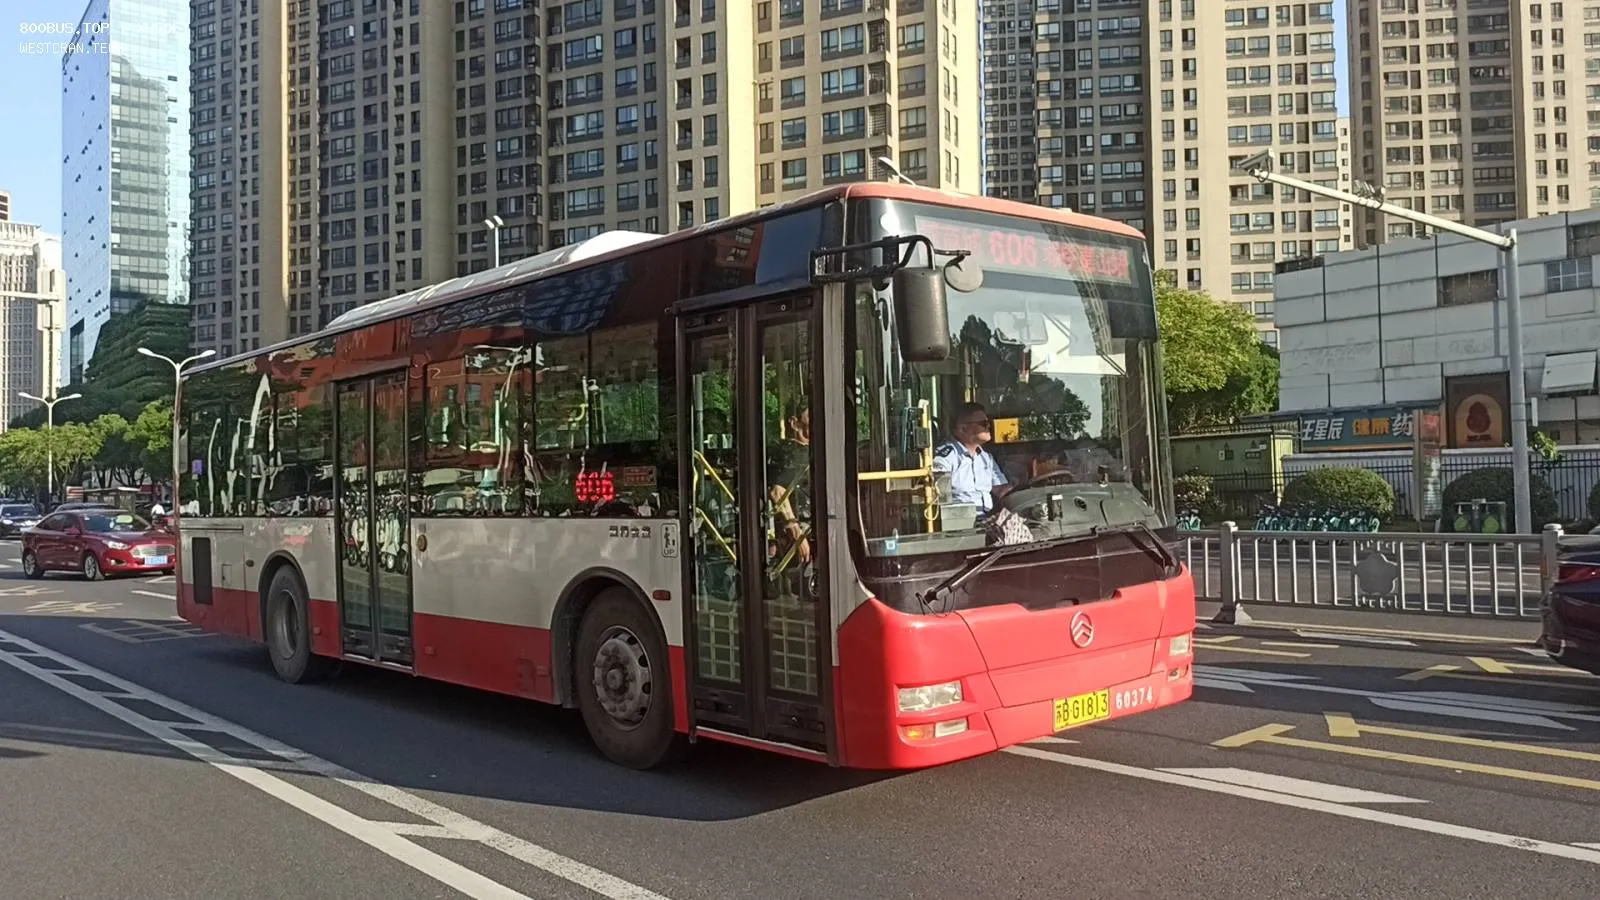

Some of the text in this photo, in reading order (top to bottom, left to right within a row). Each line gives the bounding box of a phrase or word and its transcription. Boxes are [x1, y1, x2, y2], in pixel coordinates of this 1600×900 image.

[988, 231, 1037, 268] 606
[575, 471, 616, 502] 606
[1115, 685, 1154, 710] 60374
